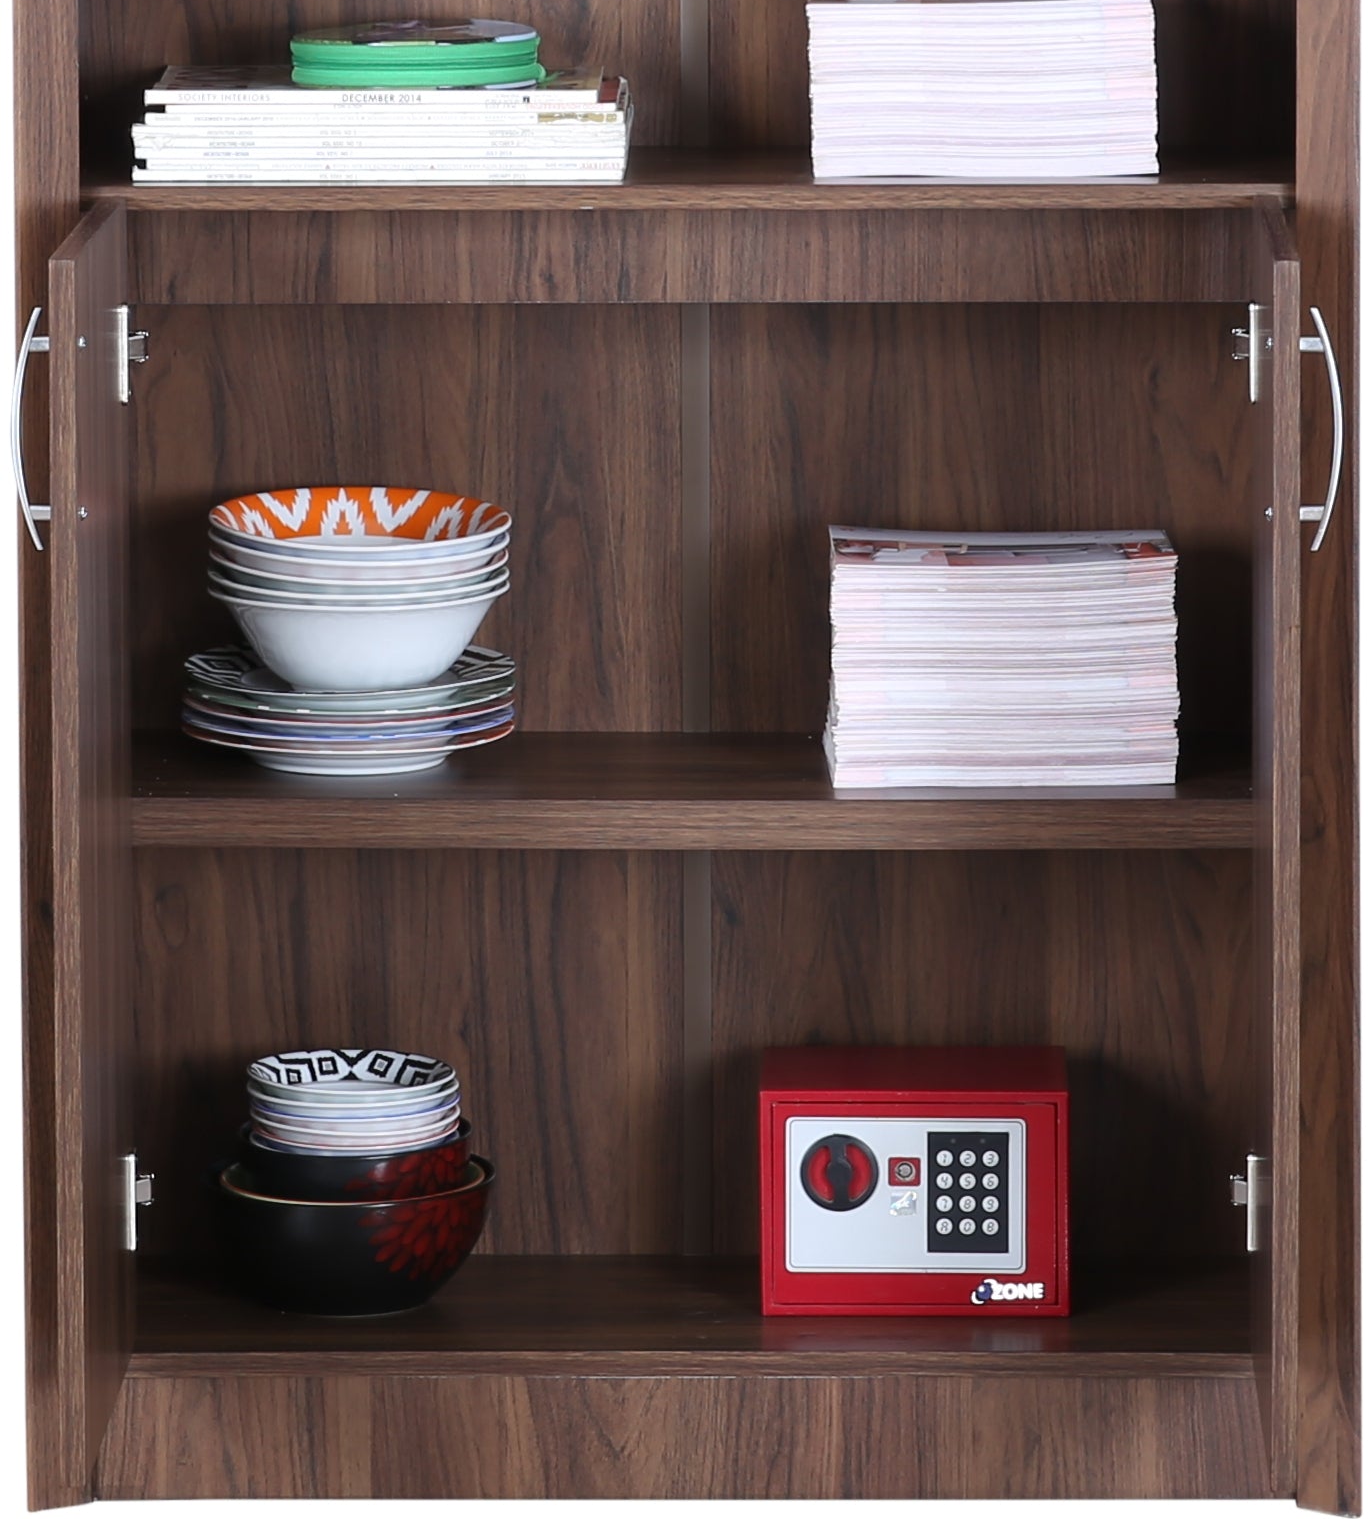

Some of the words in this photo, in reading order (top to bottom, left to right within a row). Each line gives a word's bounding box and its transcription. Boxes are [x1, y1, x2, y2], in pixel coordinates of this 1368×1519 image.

[178, 93, 217, 102] SOCIETY
[221, 93, 271, 102] INTERIORS
[342, 93, 395, 102] DECEMBER
[398, 93, 422, 102] 2014
[963, 1153, 972, 1164] 2
[986, 1153, 995, 1164] 3
[940, 1175, 949, 1187] 4
[964, 1175, 972, 1187] 5
[986, 1176, 995, 1187] 6
[941, 1198, 948, 1209] 7
[963, 1198, 972, 1210] 8
[986, 1198, 995, 1210] 9
